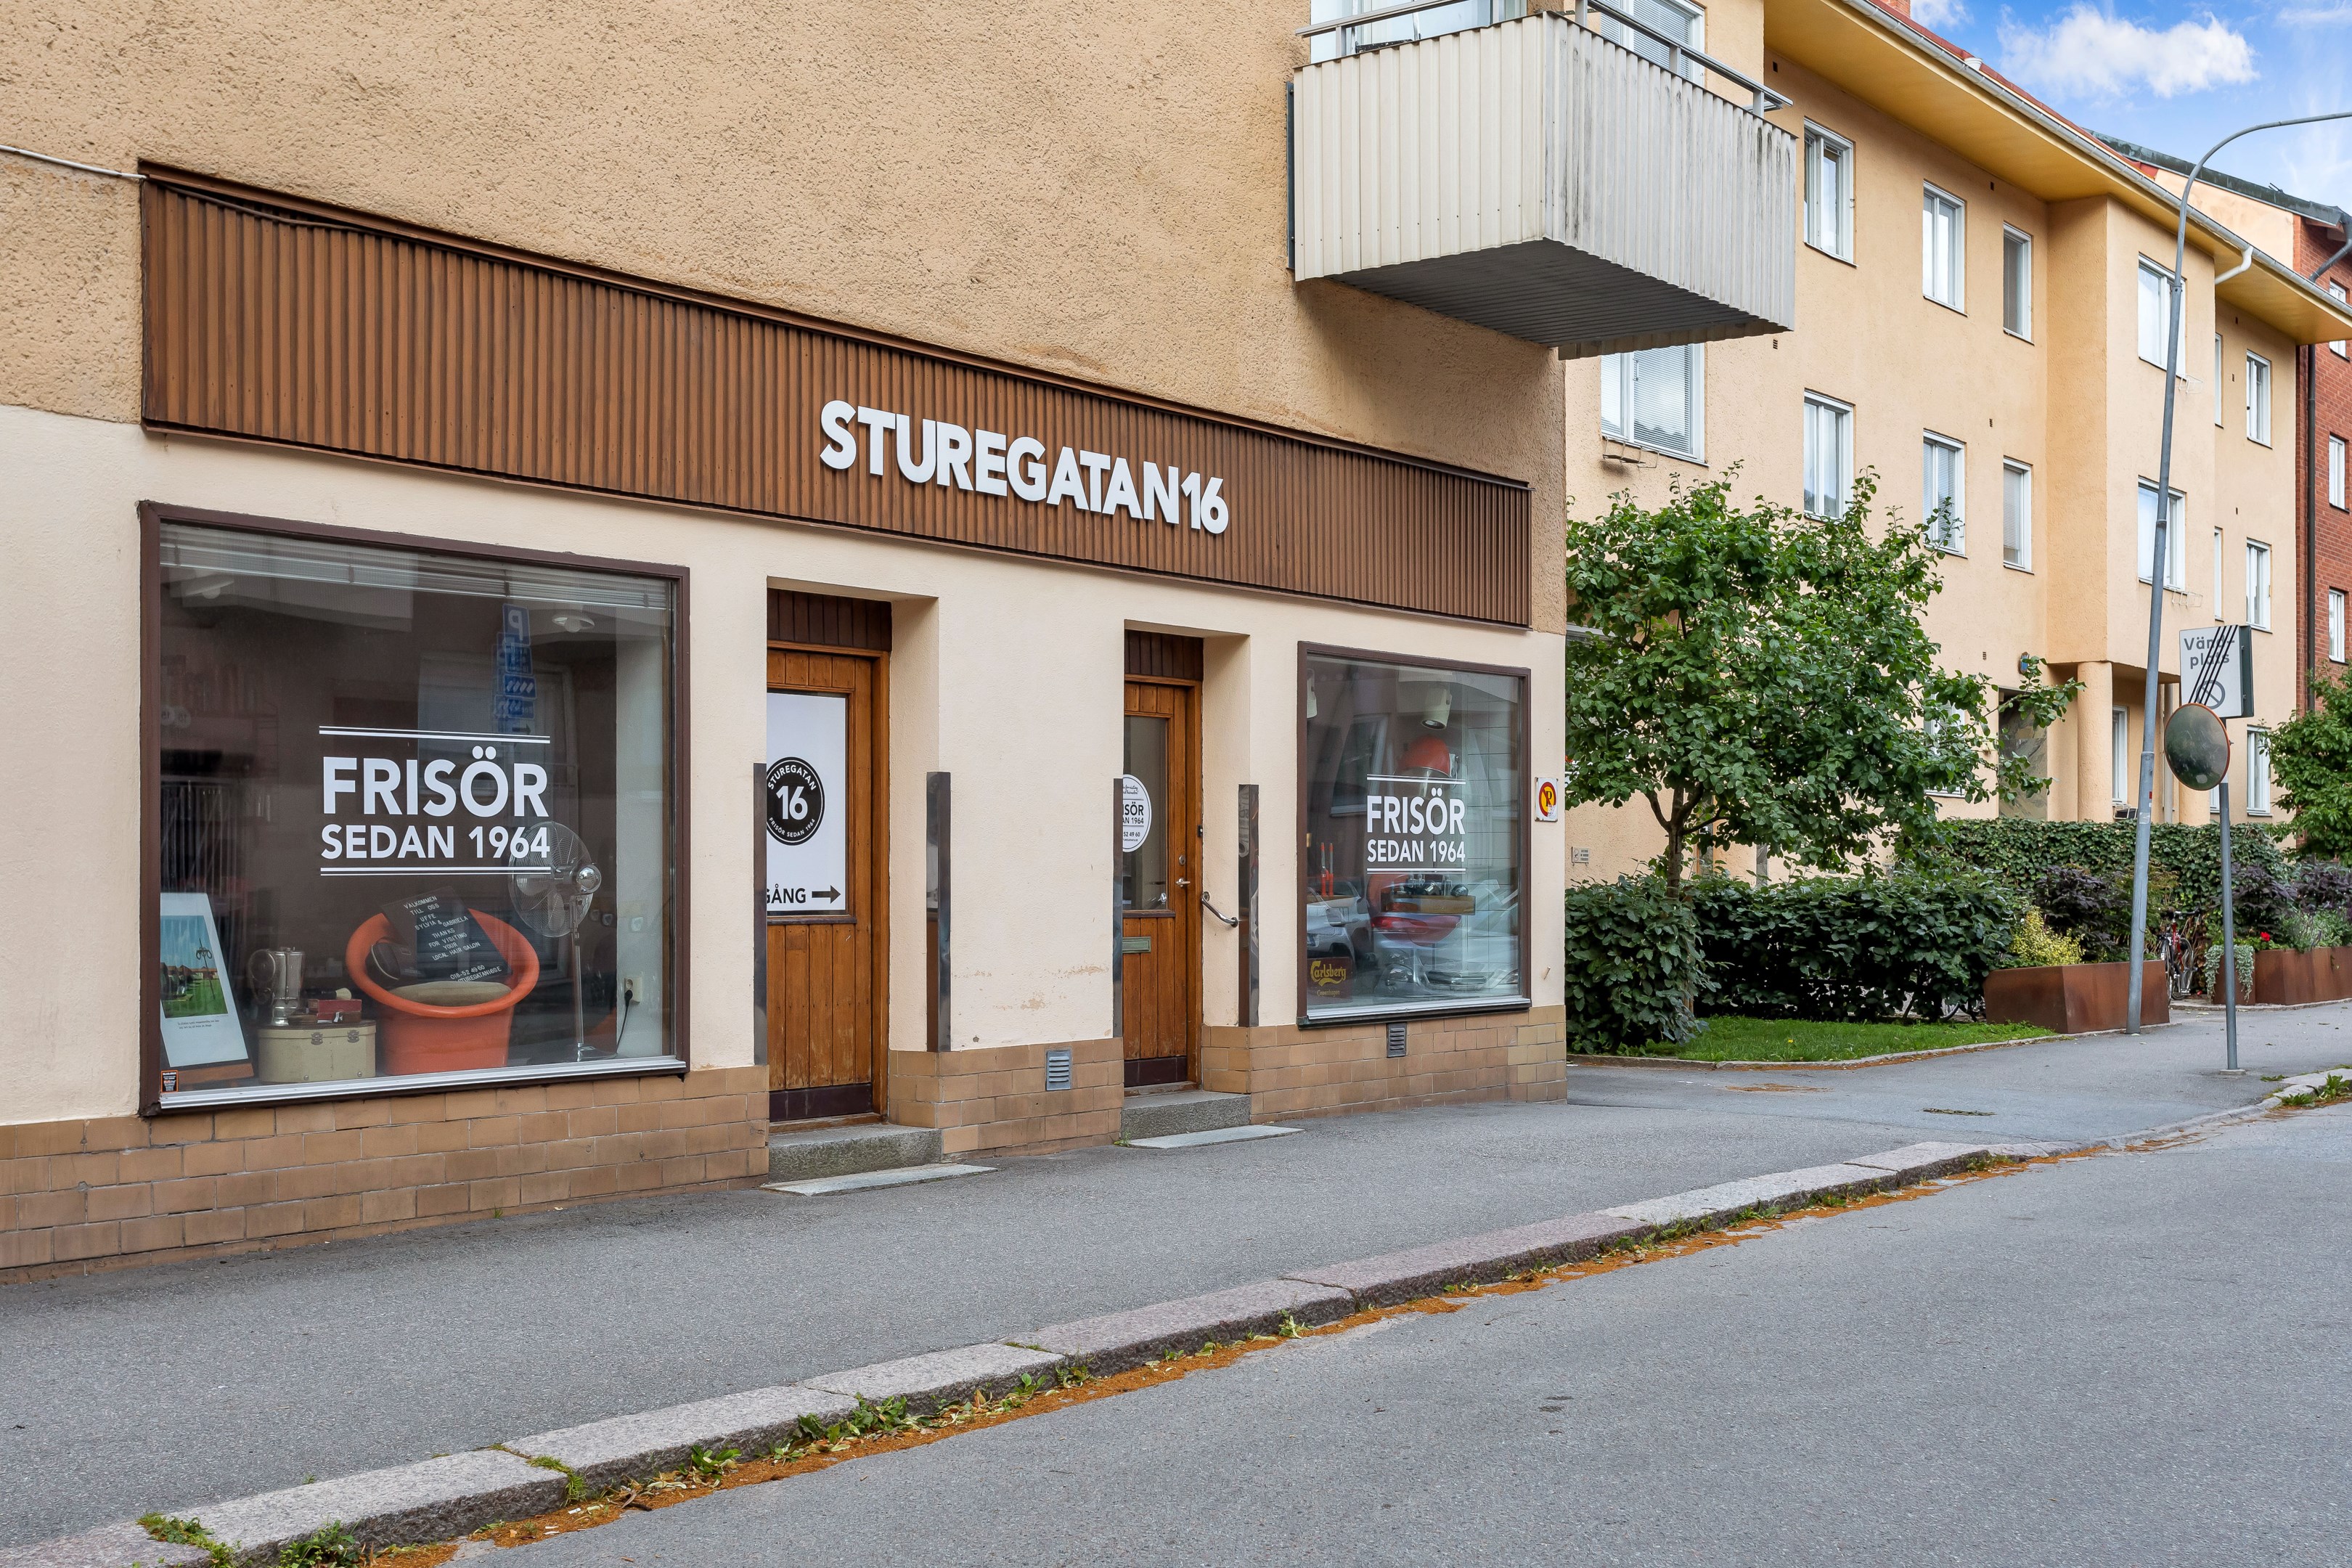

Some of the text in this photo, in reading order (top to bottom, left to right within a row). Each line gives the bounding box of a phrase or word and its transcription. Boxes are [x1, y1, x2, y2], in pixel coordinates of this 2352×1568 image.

[323, 746, 549, 817] FRISÖR
[768, 764, 817, 791] STUREGATAN
[776, 785, 808, 820] 16
[1367, 787, 1466, 835] FRISÖR
[769, 817, 785, 836] FRISÖR
[805, 818, 815, 831] 1964
[321, 824, 550, 859] SEDAN 1964
[1367, 839, 1466, 862] SEDAN 1964
[420, 913, 436, 922] UFFE
[443, 916, 469, 927] GABRIELA
[432, 928, 455, 939] THANKS
[442, 932, 467, 944] VISITING
[432, 952, 449, 961] LOCAL
[462, 942, 481, 951] SALON
[443, 942, 458, 950] YOUR
[1310, 960, 1347, 985] Carlsberg
